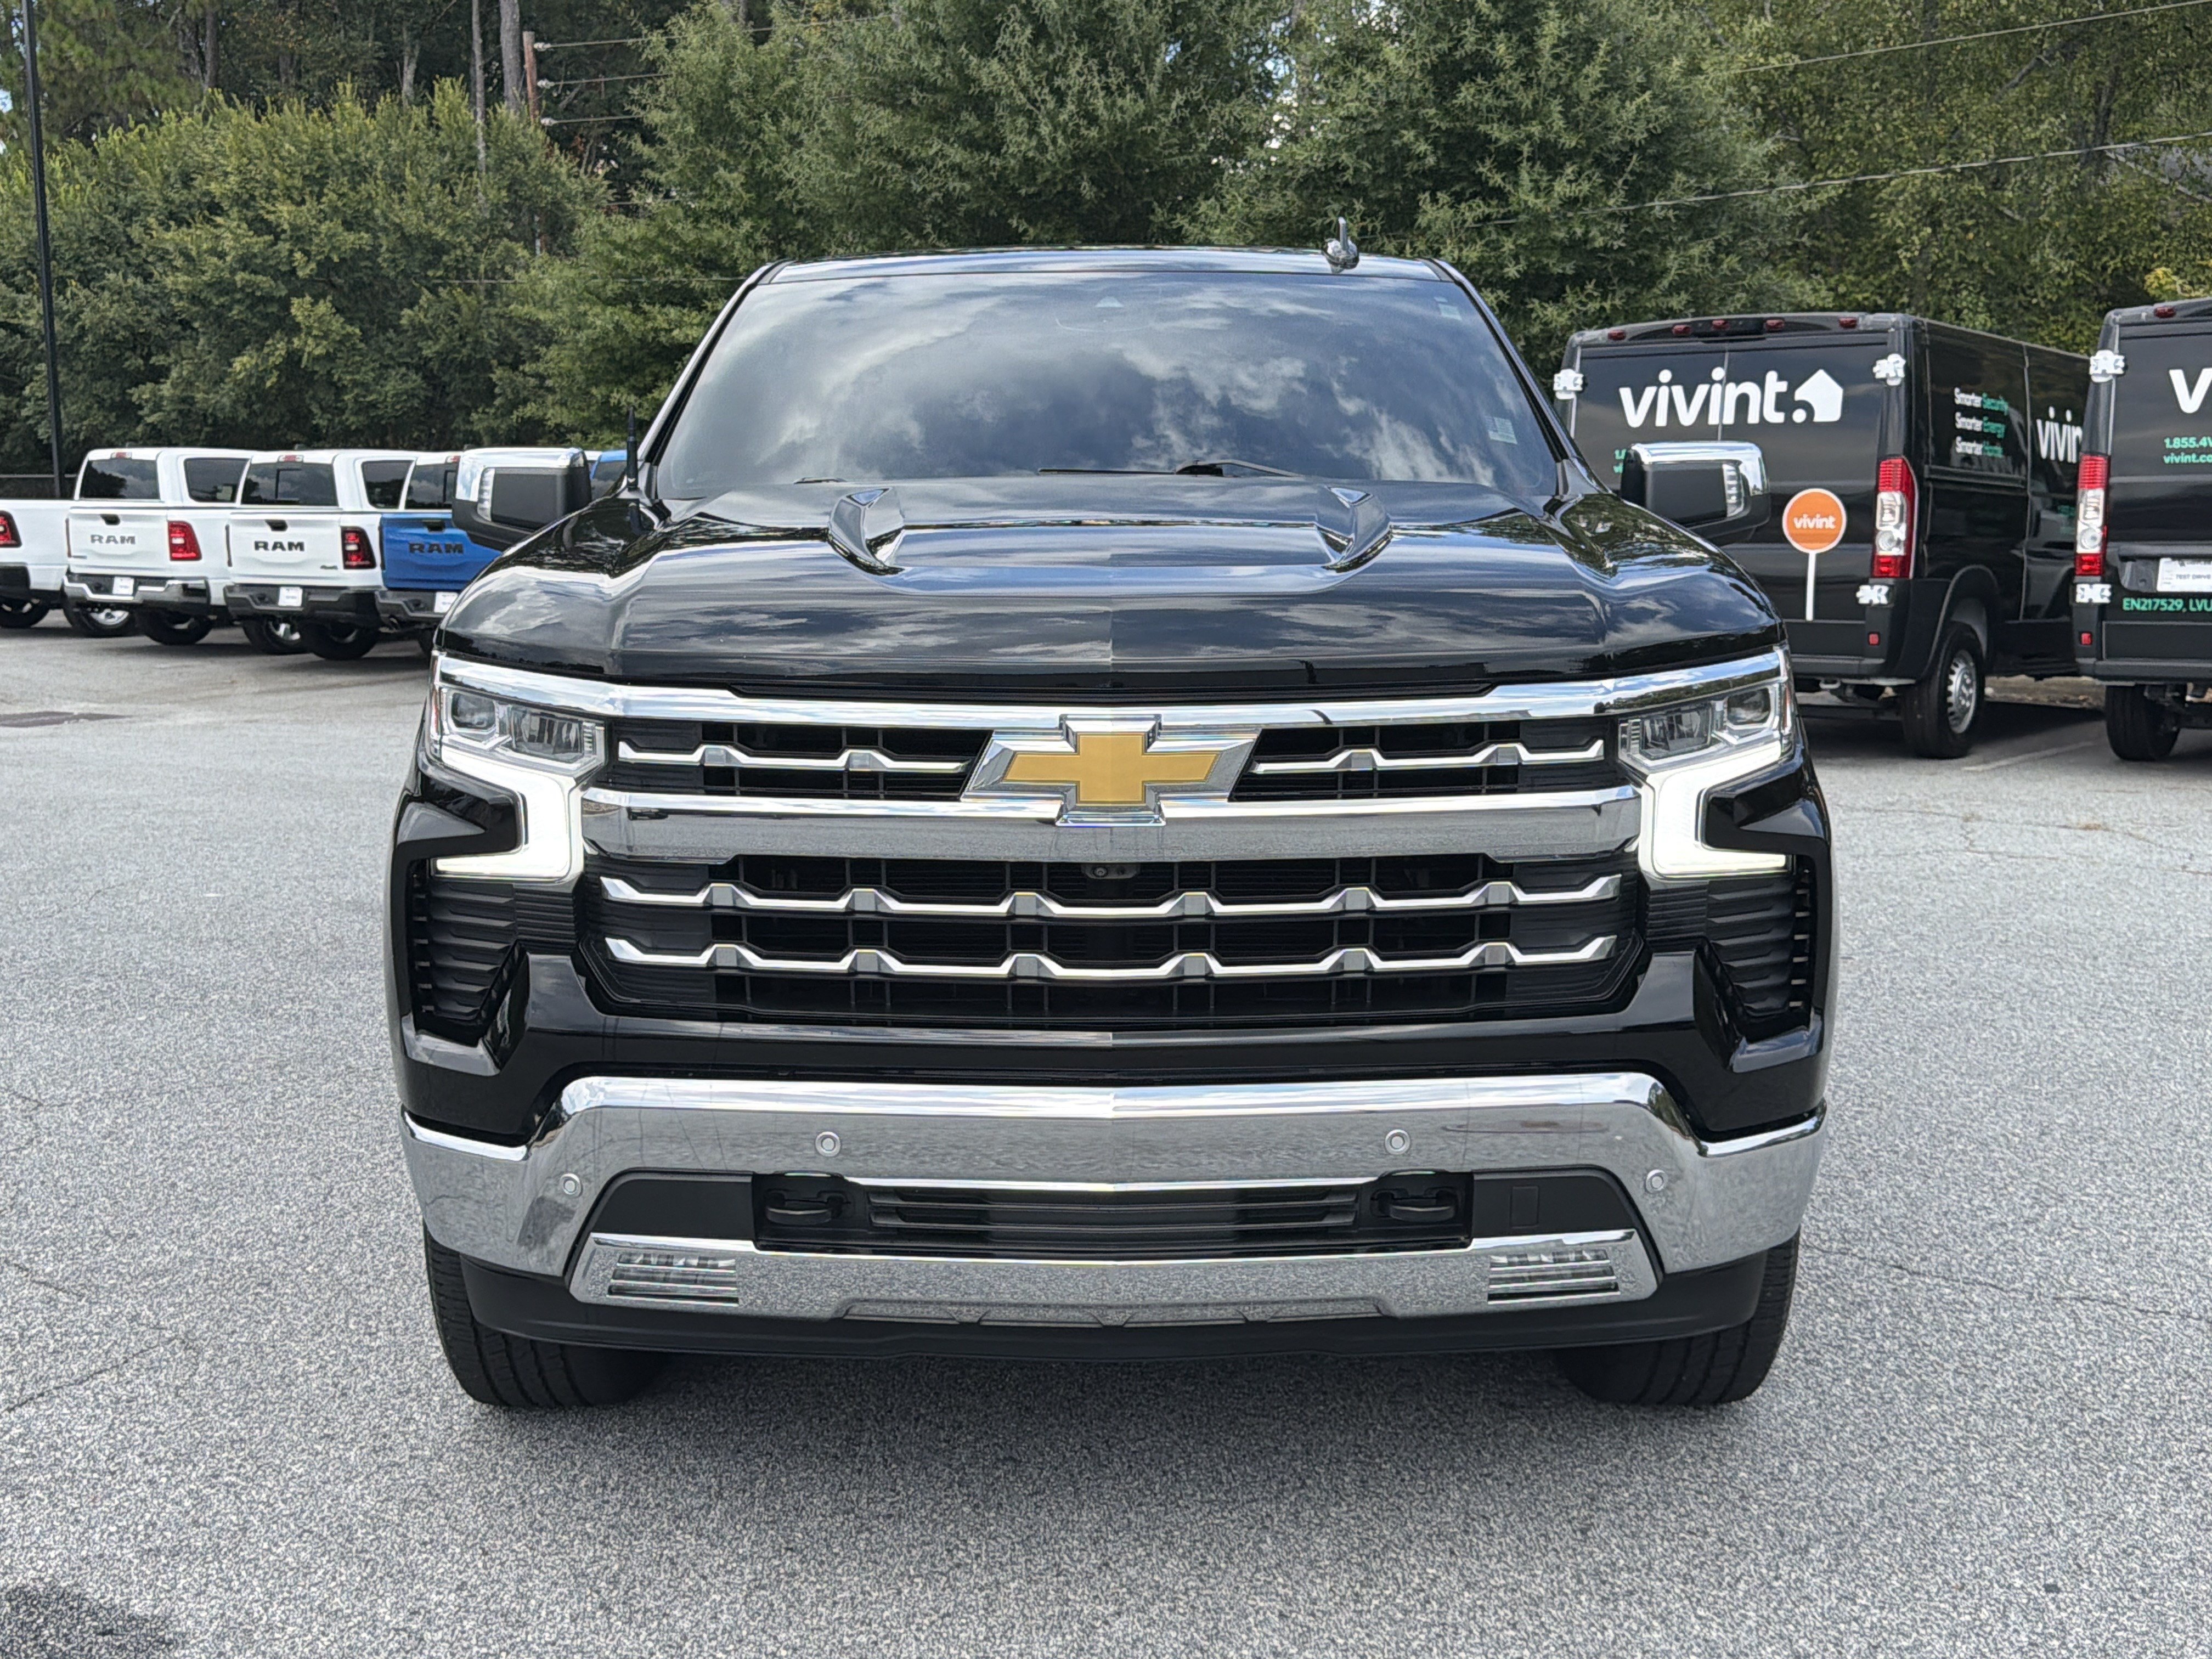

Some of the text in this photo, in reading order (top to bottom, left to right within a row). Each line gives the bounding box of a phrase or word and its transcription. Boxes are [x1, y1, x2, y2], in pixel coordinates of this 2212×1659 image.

[2036, 406, 2083, 464] vivin
[1793, 513, 1836, 529] vivint
[90, 534, 136, 545] RAM
[254, 540, 305, 551] RAM
[408, 543, 464, 554] RAM
